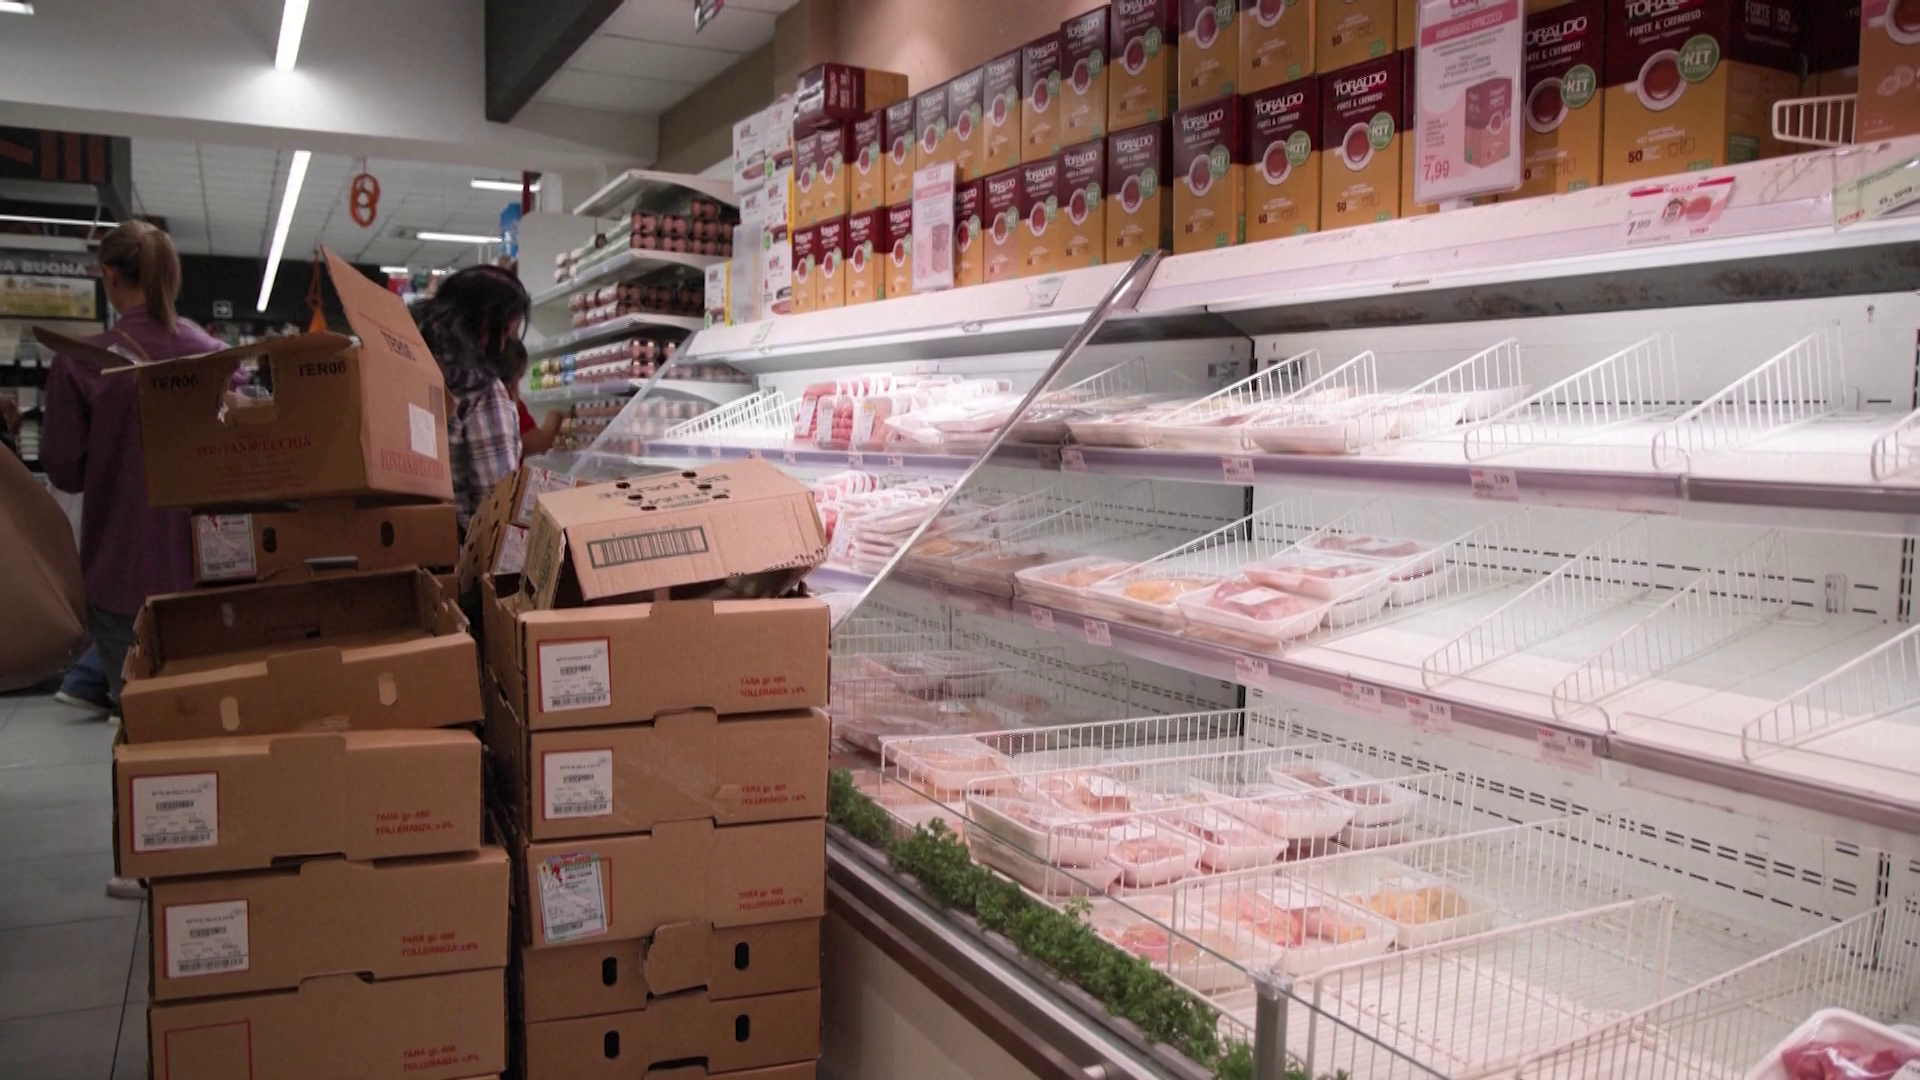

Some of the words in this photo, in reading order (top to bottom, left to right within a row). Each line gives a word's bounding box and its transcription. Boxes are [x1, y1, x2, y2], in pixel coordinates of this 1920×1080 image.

[1630, 22, 1652, 37] FORTE
[1655, 20, 1660, 30] &
[1664, 9, 1702, 28] CREMOSO
[1526, 16, 1588, 46] ORALDO
[1684, 50, 1712, 67] KIT
[1335, 71, 1388, 98] TORALDO
[1567, 78, 1591, 92] KIT
[1255, 93, 1304, 116] TORALDO
[1181, 109, 1224, 132] TORALDO
[1371, 124, 1390, 136] KIT
[1288, 142, 1307, 154] KIT
[1628, 150, 1643, 163] 50
[1424, 161, 1450, 182] 7,99
[1337, 201, 1347, 213] 50
[1259, 213, 1267, 225] 50
[22, 260, 89, 275] BUONA
[297, 361, 347, 377] TER06
[741, 677, 760, 685] TARA
[741, 687, 788, 697] TOLLERANZA
[376, 823, 432, 836] TOLLERANZA
